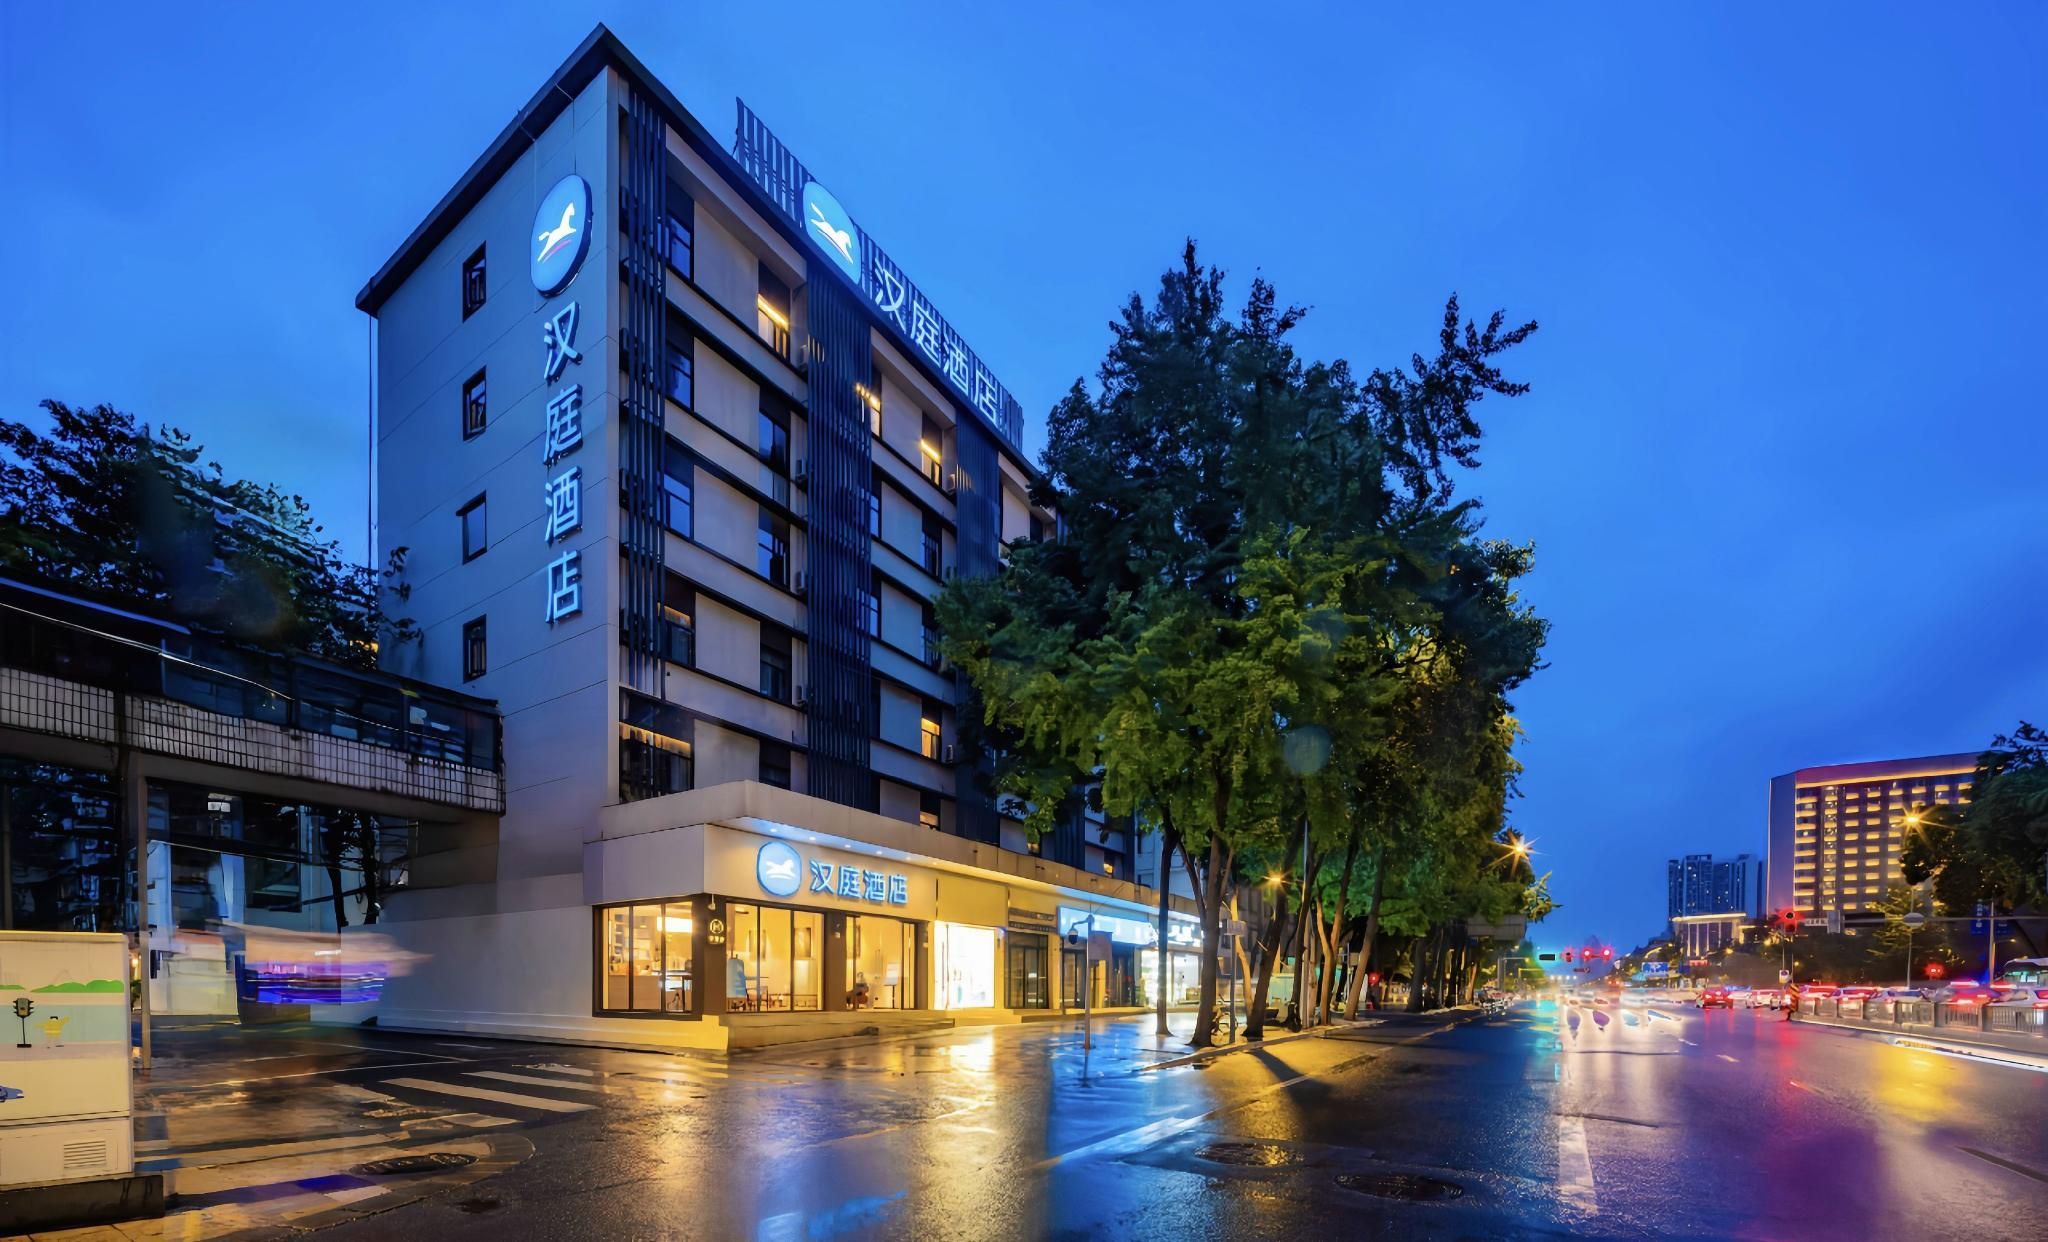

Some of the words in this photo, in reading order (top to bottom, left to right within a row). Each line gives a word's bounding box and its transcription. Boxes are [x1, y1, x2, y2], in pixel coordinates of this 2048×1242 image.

[874, 258, 998, 428] 汉庭酒店
[543, 301, 583, 624] 汉庭酒店
[809, 860, 908, 904] 汉庭酒店
